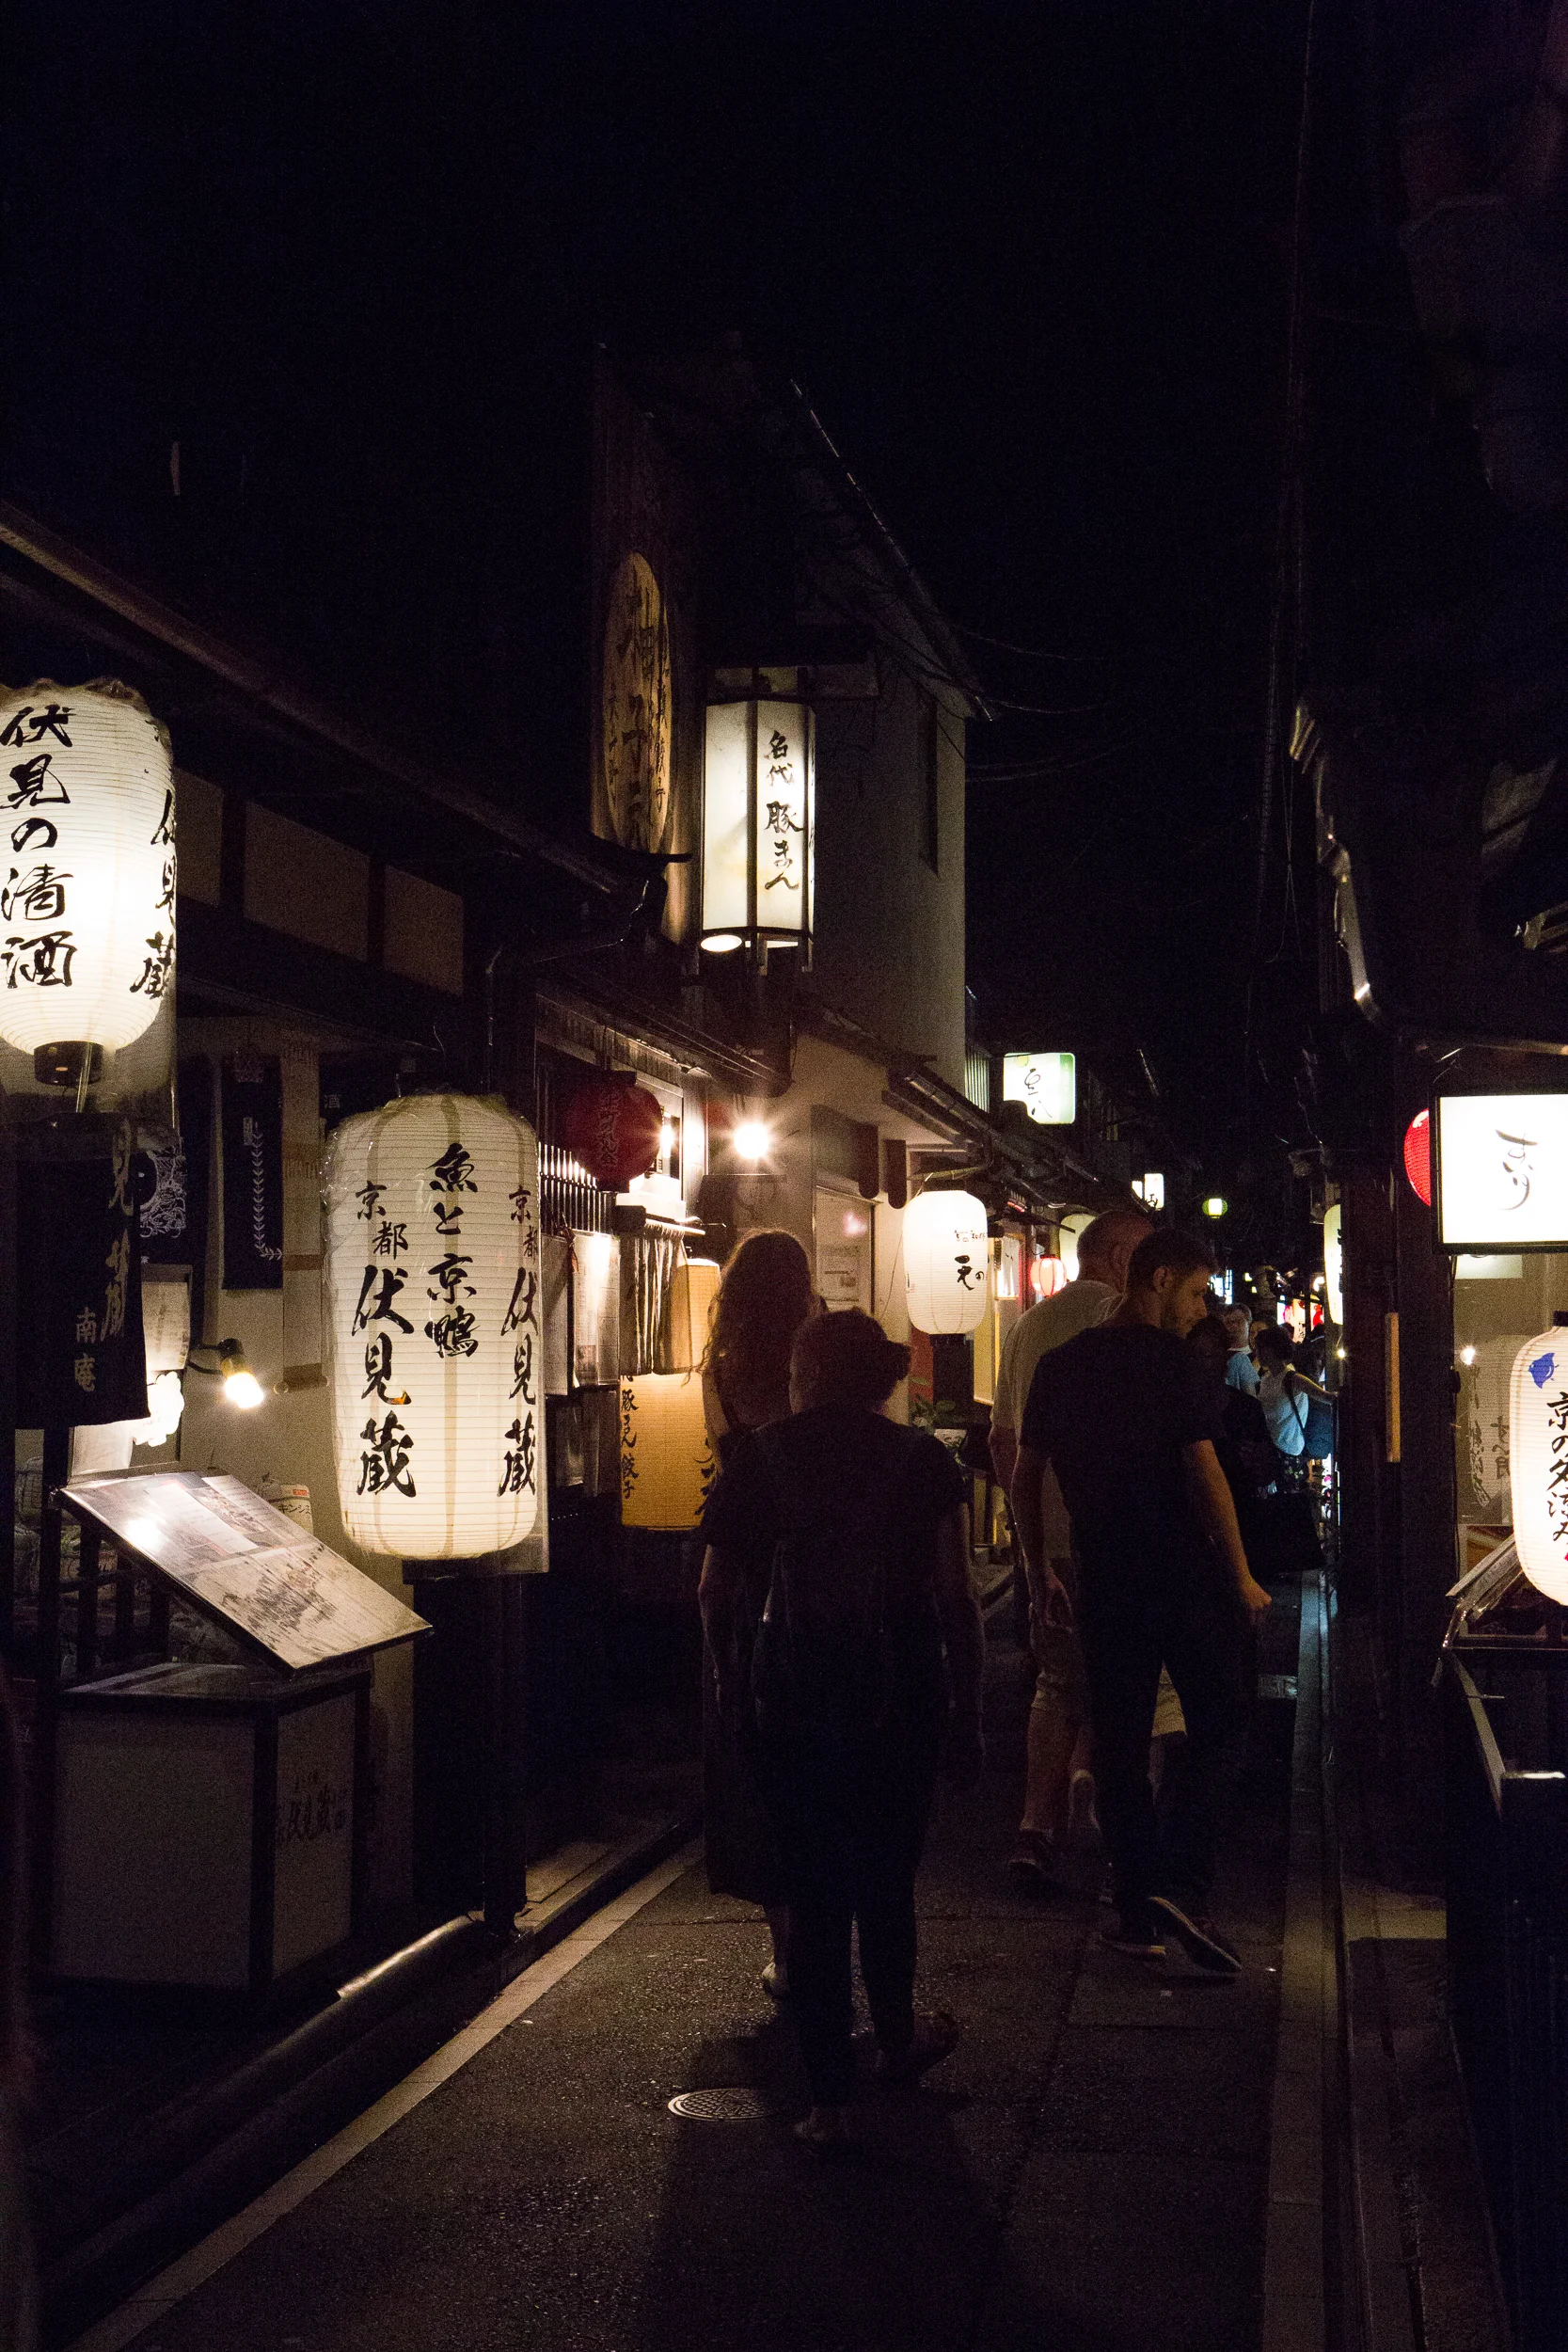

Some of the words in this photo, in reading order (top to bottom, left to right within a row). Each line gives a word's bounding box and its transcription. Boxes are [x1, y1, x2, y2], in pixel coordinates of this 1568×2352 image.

[0, 704, 76, 990] 伏見の清酒
[423, 1142, 482, 1360] 魚と京鴨
